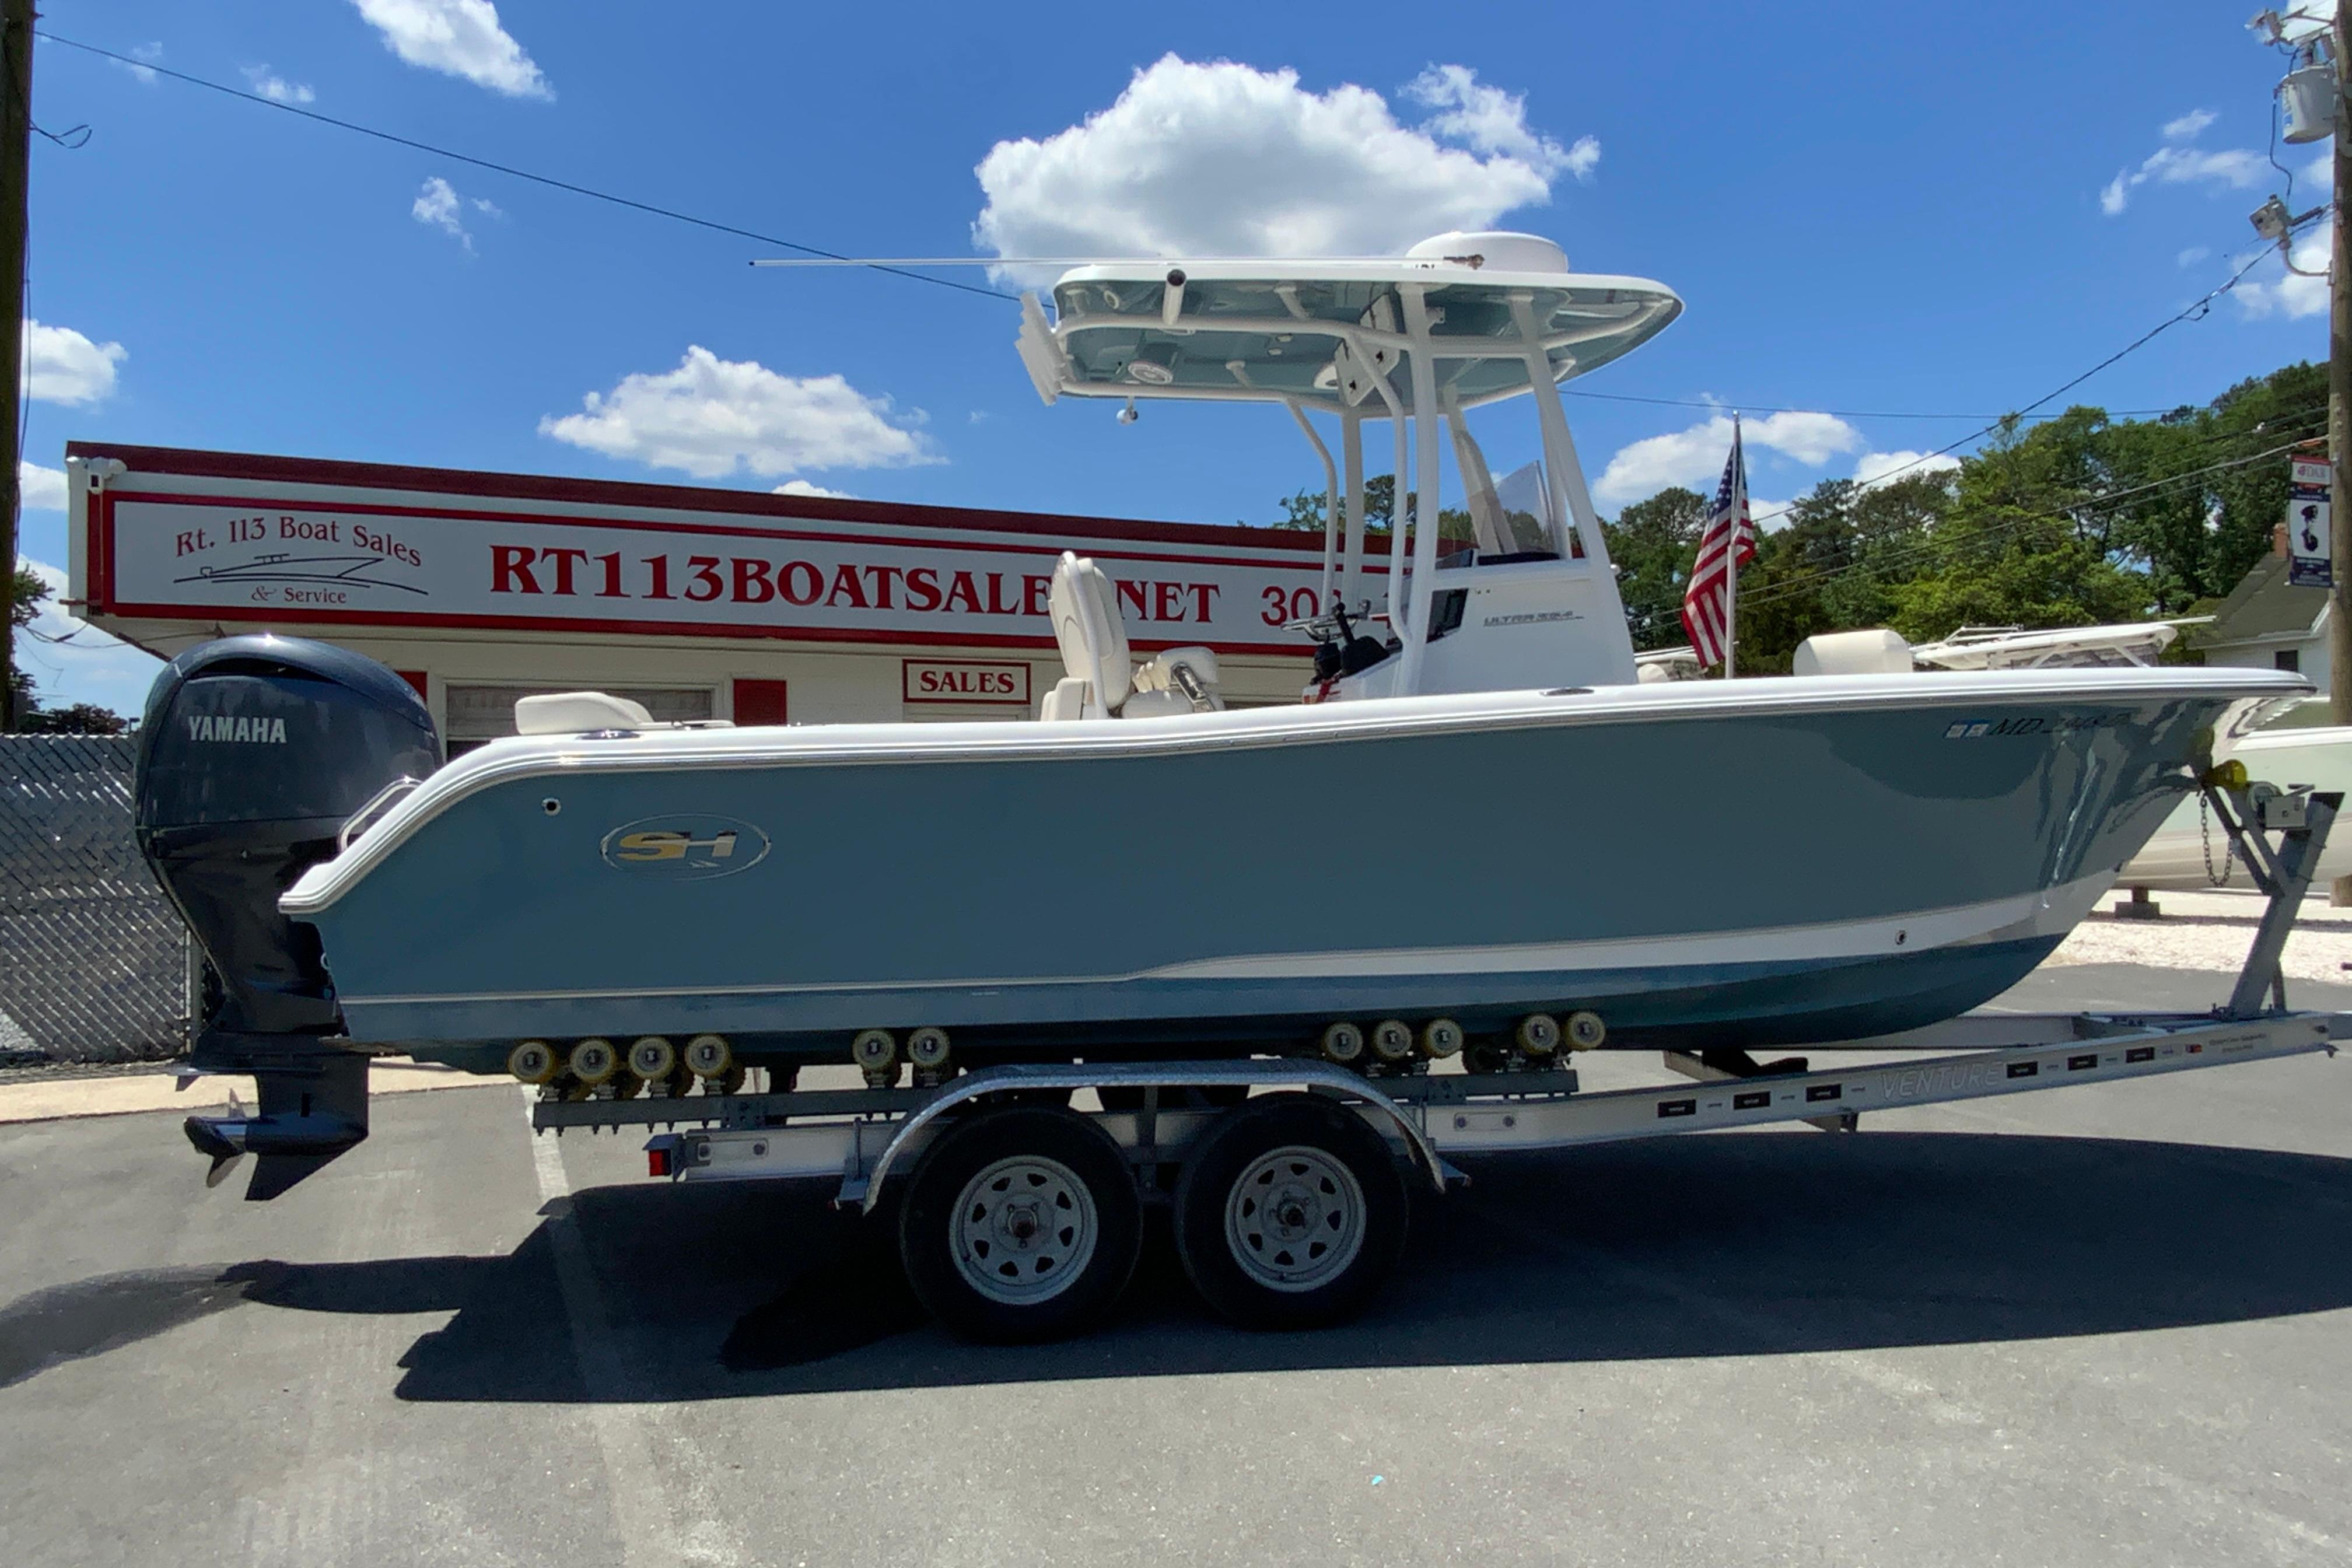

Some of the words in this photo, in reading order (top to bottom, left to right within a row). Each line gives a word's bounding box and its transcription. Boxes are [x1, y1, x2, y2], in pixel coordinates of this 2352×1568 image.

[176, 528, 215, 557] Rt.
[229, 517, 266, 544] 113
[279, 516, 341, 542] Boat
[353, 524, 422, 567] Sales
[251, 585, 277, 601] &
[284, 587, 346, 604] Service
[489, 544, 1221, 623] RT113BOATSALENET
[919, 671, 1015, 693] SALES
[188, 716, 287, 744] YAMAHA
[1881, 1061, 2003, 1101] VENTURE
